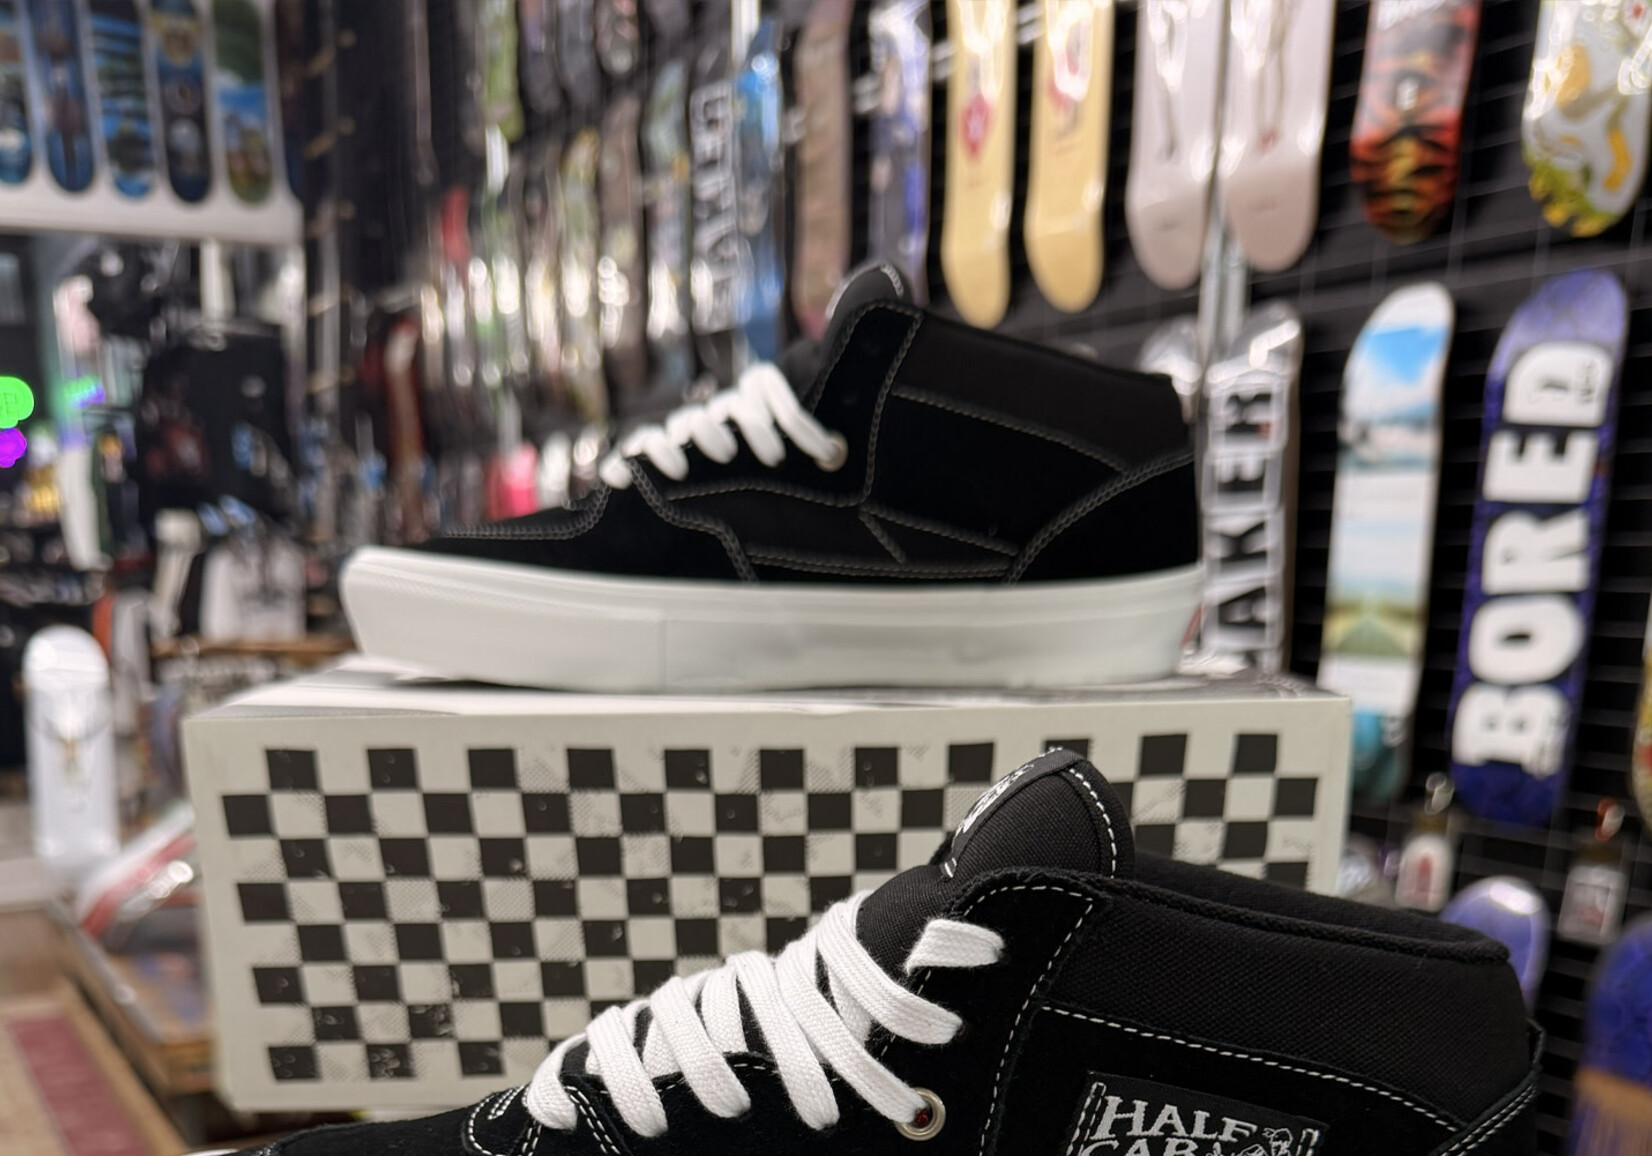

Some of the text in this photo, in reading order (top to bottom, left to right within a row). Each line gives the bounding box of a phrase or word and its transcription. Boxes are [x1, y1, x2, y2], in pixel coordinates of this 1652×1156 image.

[1202, 370, 1288, 676] AKER
[1451, 342, 1614, 778] BORED
[1090, 1095, 1258, 1142] HALF
